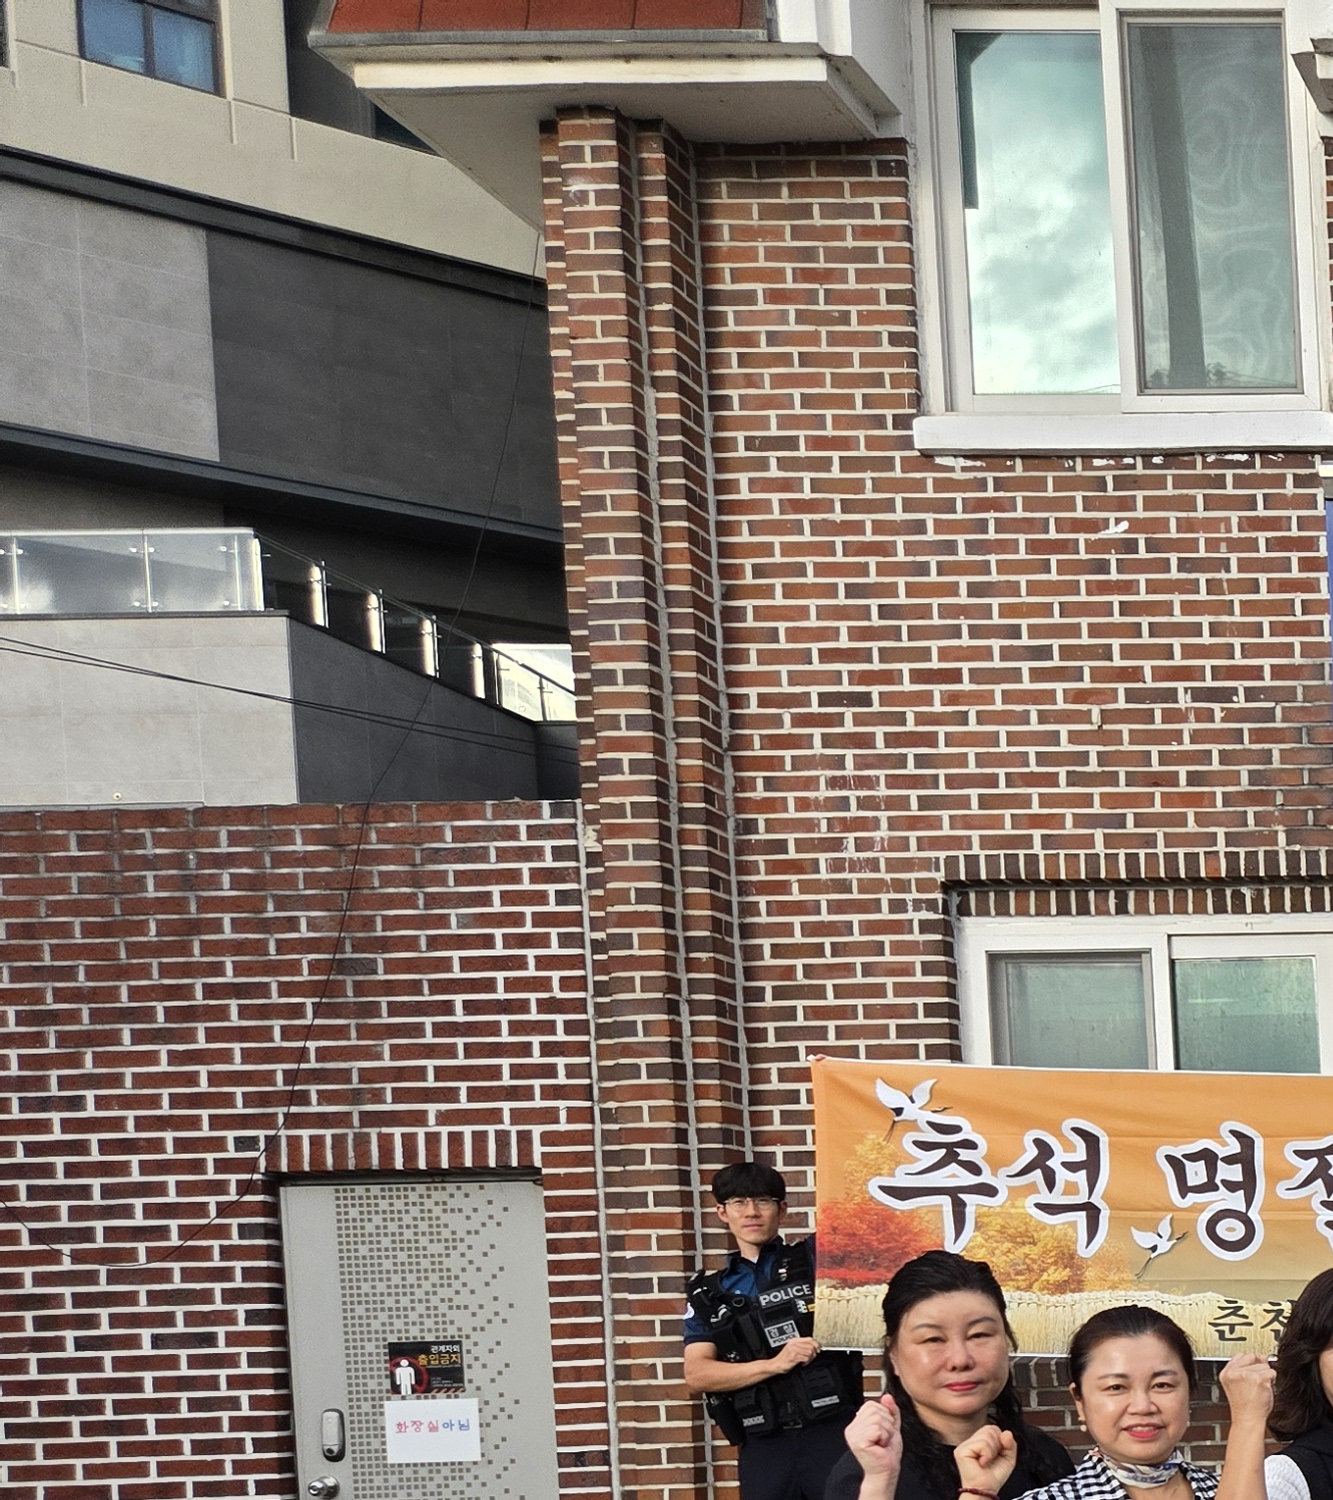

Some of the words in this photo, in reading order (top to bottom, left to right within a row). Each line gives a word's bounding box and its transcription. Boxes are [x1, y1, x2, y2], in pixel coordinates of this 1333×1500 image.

[873, 1118, 1107, 1257] 추석
[760, 1284, 812, 1307] POLICE
[418, 1354, 461, 1365] 출입금지
[396, 1420, 439, 1433] 화장실
[442, 1419, 470, 1431] 아님
